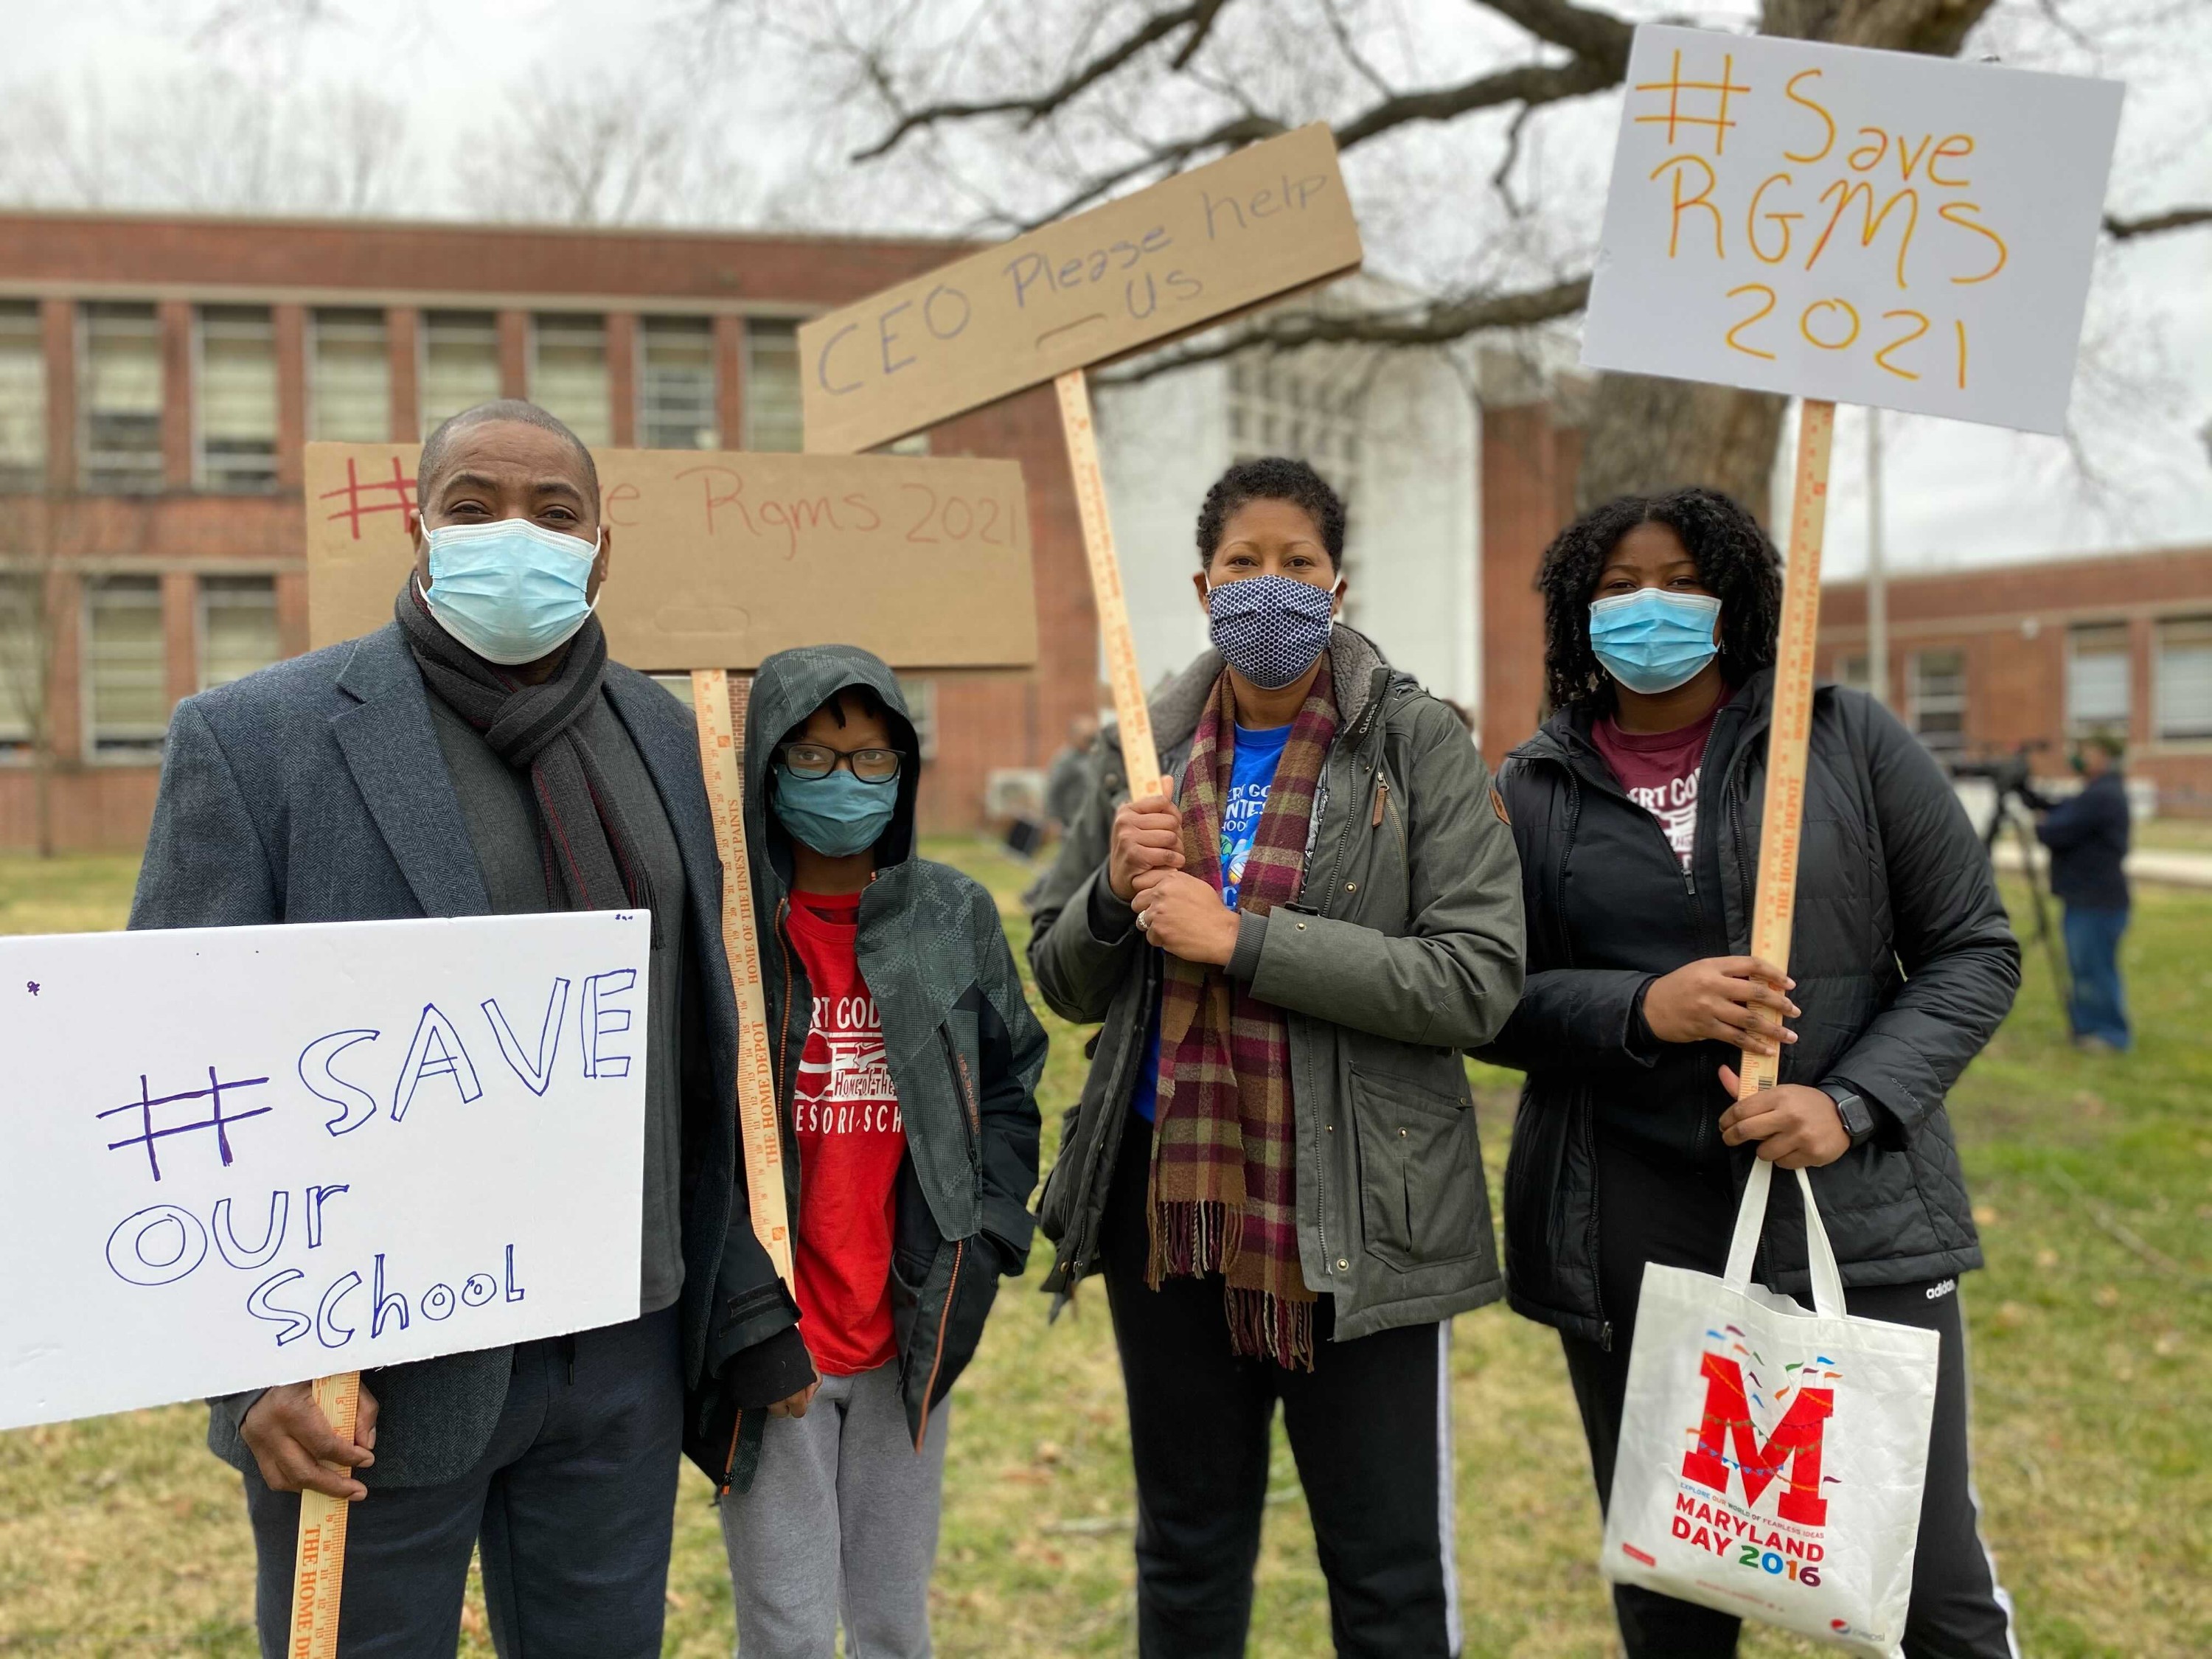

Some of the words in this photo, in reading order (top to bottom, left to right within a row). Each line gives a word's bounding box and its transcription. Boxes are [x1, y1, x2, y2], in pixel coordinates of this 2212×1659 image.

[1649, 154, 2007, 289] RGMS
[818, 285, 972, 395] CEO
[1004, 225, 1173, 308] Please
[1726, 283, 1966, 389] 2021
[901, 482, 1019, 546] 2021
[728, 799, 742, 844] PAINTS
[734, 847, 748, 891] FINEST
[740, 894, 751, 922] THE
[742, 925, 754, 942] OF
[745, 944, 759, 984] HOME
[752, 1020, 769, 1076] DEPOT
[759, 1078, 774, 1130] HOME
[764, 1132, 779, 1167] THE
[1676, 1492, 1824, 1562] MARYLAND
[1680, 1482, 1711, 1500] EXPLORE
[1712, 1495, 1726, 1506] OUR
[1728, 1503, 1750, 1517] WORLD
[1751, 1513, 1761, 1521] OF
[1762, 1518, 1801, 1535] FEARLESS
[1803, 1531, 1825, 1540] IDEAS
[302, 1524, 321, 1567] THE
[1672, 1515, 1733, 1557] DAY
[1739, 1545, 1821, 1587] 2016
[297, 1570, 317, 1632] HOME
